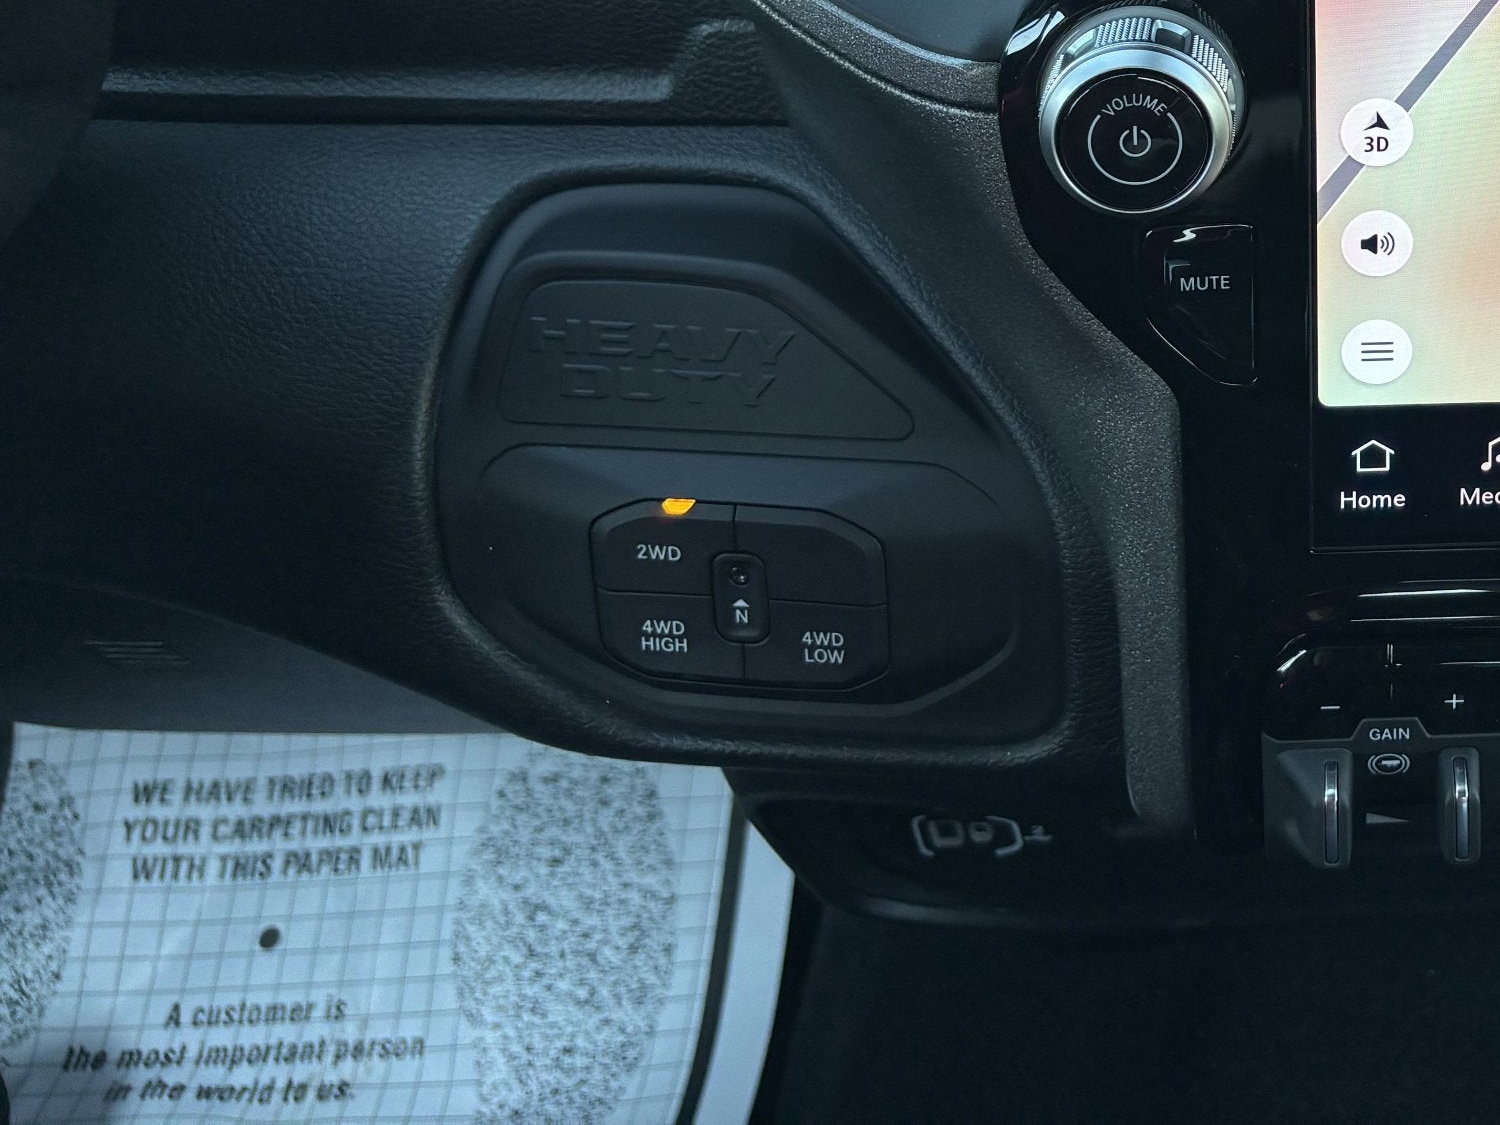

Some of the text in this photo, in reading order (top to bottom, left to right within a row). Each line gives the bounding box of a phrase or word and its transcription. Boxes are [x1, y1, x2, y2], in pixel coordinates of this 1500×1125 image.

[1102, 95, 1167, 117] VOLUME
[1363, 136, 1389, 153] 3D
[1180, 275, 1231, 291] MUTE
[529, 316, 797, 365] HEAVY
[1339, 490, 1407, 510] Home
[636, 545, 682, 562] 2WD
[734, 609, 748, 625] N
[641, 619, 685, 636] 4WD
[640, 637, 689, 654] HIGH
[801, 631, 845, 648] 4WD
[804, 649, 845, 665] LOW
[1368, 727, 1411, 741] GAIN
[131, 763, 446, 805] WE HAVE TRIED TO KEEP
[122, 804, 442, 844] YOUR CARPETING CLEAN
[131, 843, 423, 882] WITH THIS PAPER MAT
[164, 995, 348, 1029] A customer is
[62, 1035, 425, 1072] the most important person
[102, 1081, 132, 1103] in
[139, 1077, 187, 1101] the
[195, 1077, 275, 1105] world
[282, 1078, 310, 1103] to
